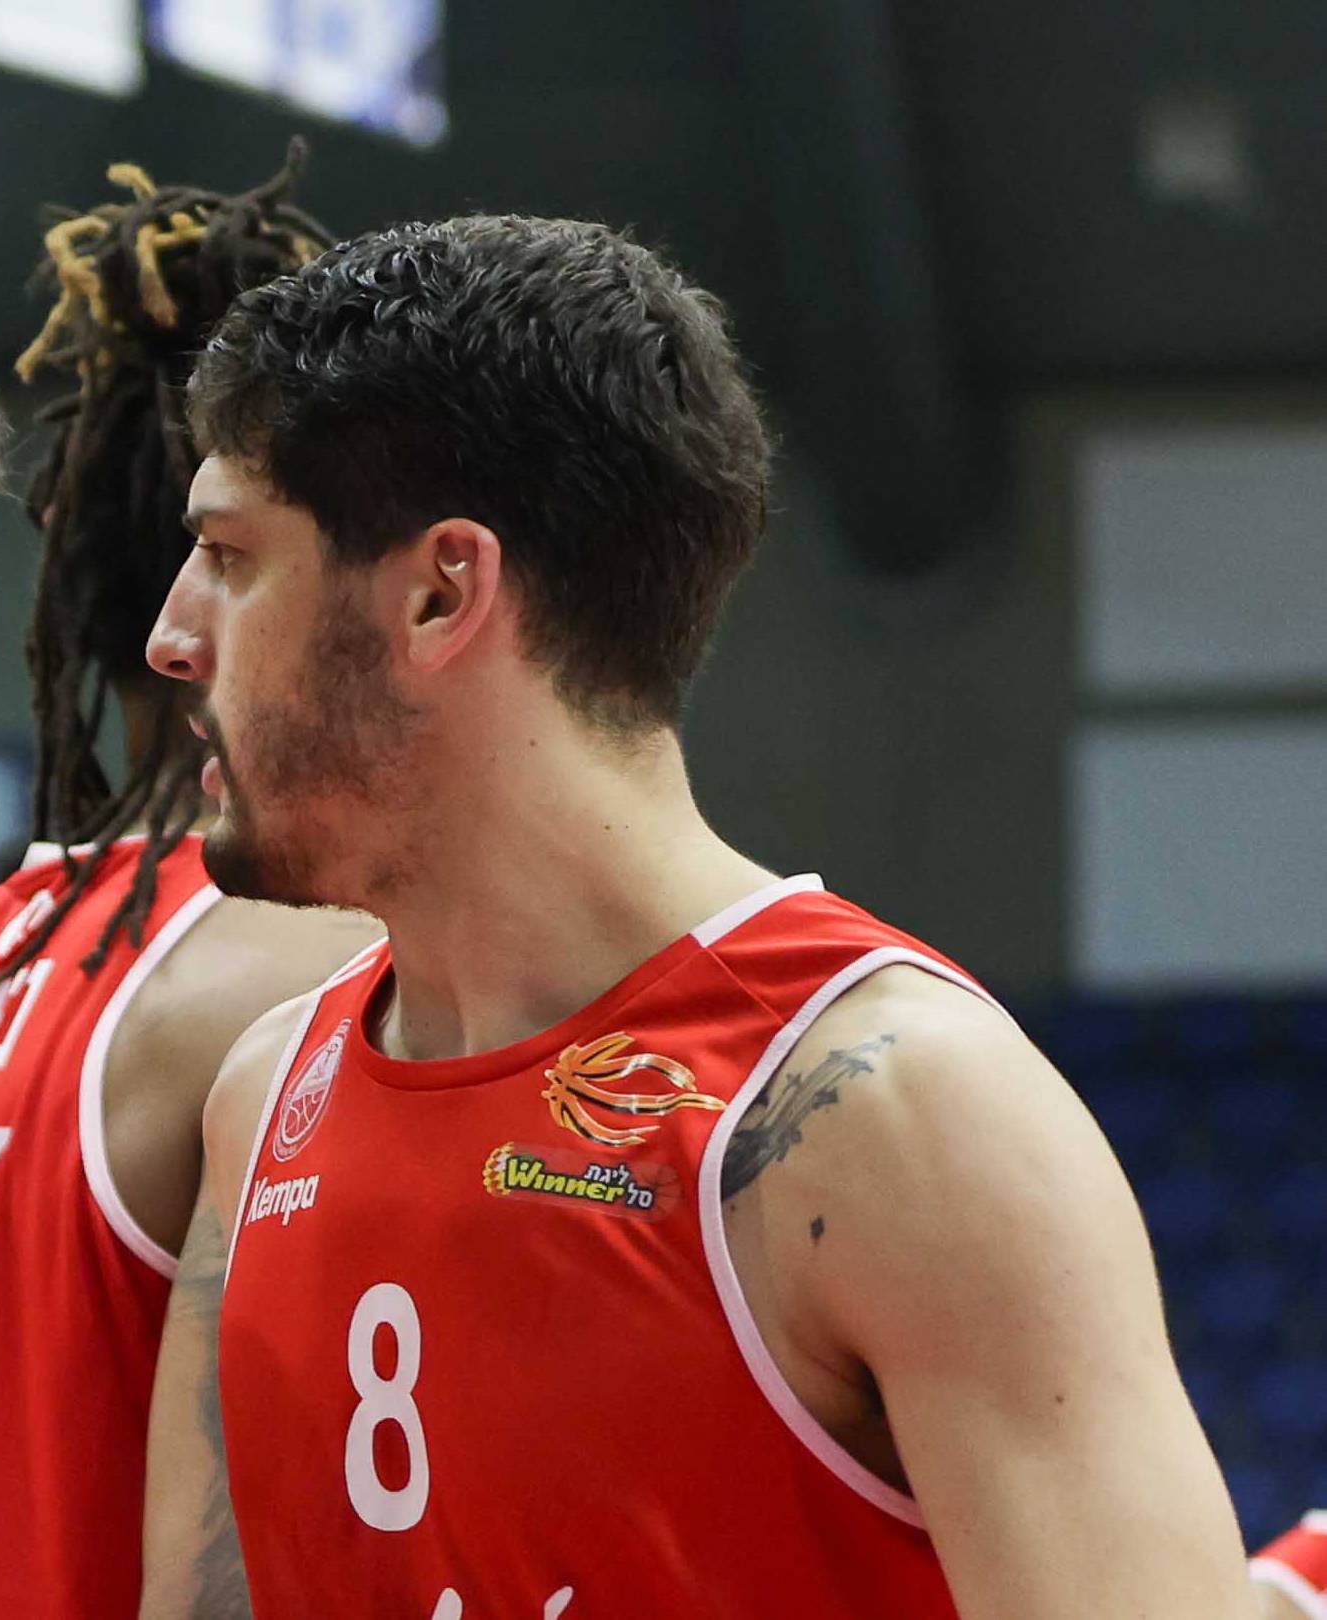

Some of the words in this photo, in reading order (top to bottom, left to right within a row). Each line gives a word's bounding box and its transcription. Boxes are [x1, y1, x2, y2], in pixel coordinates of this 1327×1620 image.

[508, 1158, 625, 1203] Winner
[584, 1164, 631, 1186] ליגת
[626, 1182, 653, 1208] סל
[245, 1175, 320, 1226] Kempa
[345, 1283, 430, 1531] 8
